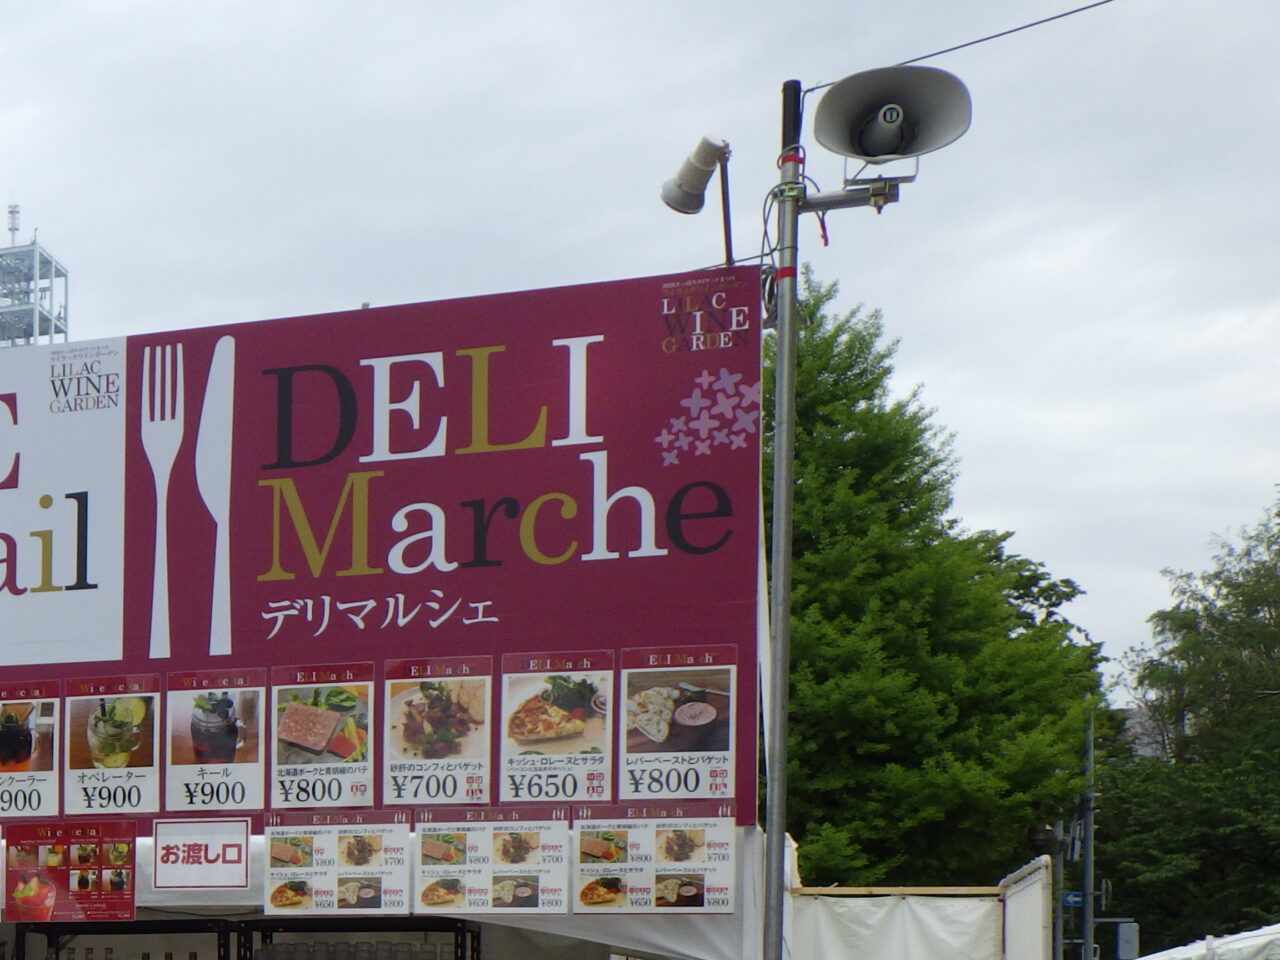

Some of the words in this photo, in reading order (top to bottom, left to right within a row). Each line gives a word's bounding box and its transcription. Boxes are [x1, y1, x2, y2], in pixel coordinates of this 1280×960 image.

[50, 360, 102, 378] LILAC
[50, 373, 120, 399] WINE
[50, 394, 119, 414] GARDEN
[261, 334, 605, 471] DELI
[257, 451, 733, 582] Marche
[261, 590, 500, 640] デリマルシェ
[77, 771, 147, 784] オペレーター
[196, 766, 233, 780] キール
[628, 768, 700, 793] ¥800
[81, 784, 141, 808] ¥900
[183, 780, 245, 805] ¥900
[278, 778, 342, 802] ¥800
[391, 774, 457, 799] ¥700
[507, 773, 577, 798] ¥650
[160, 842, 243, 865] お渡し口
[384, 857, 404, 866] ¥700
[542, 855, 563, 863] ¥700
[706, 852, 729, 861] ¥700
